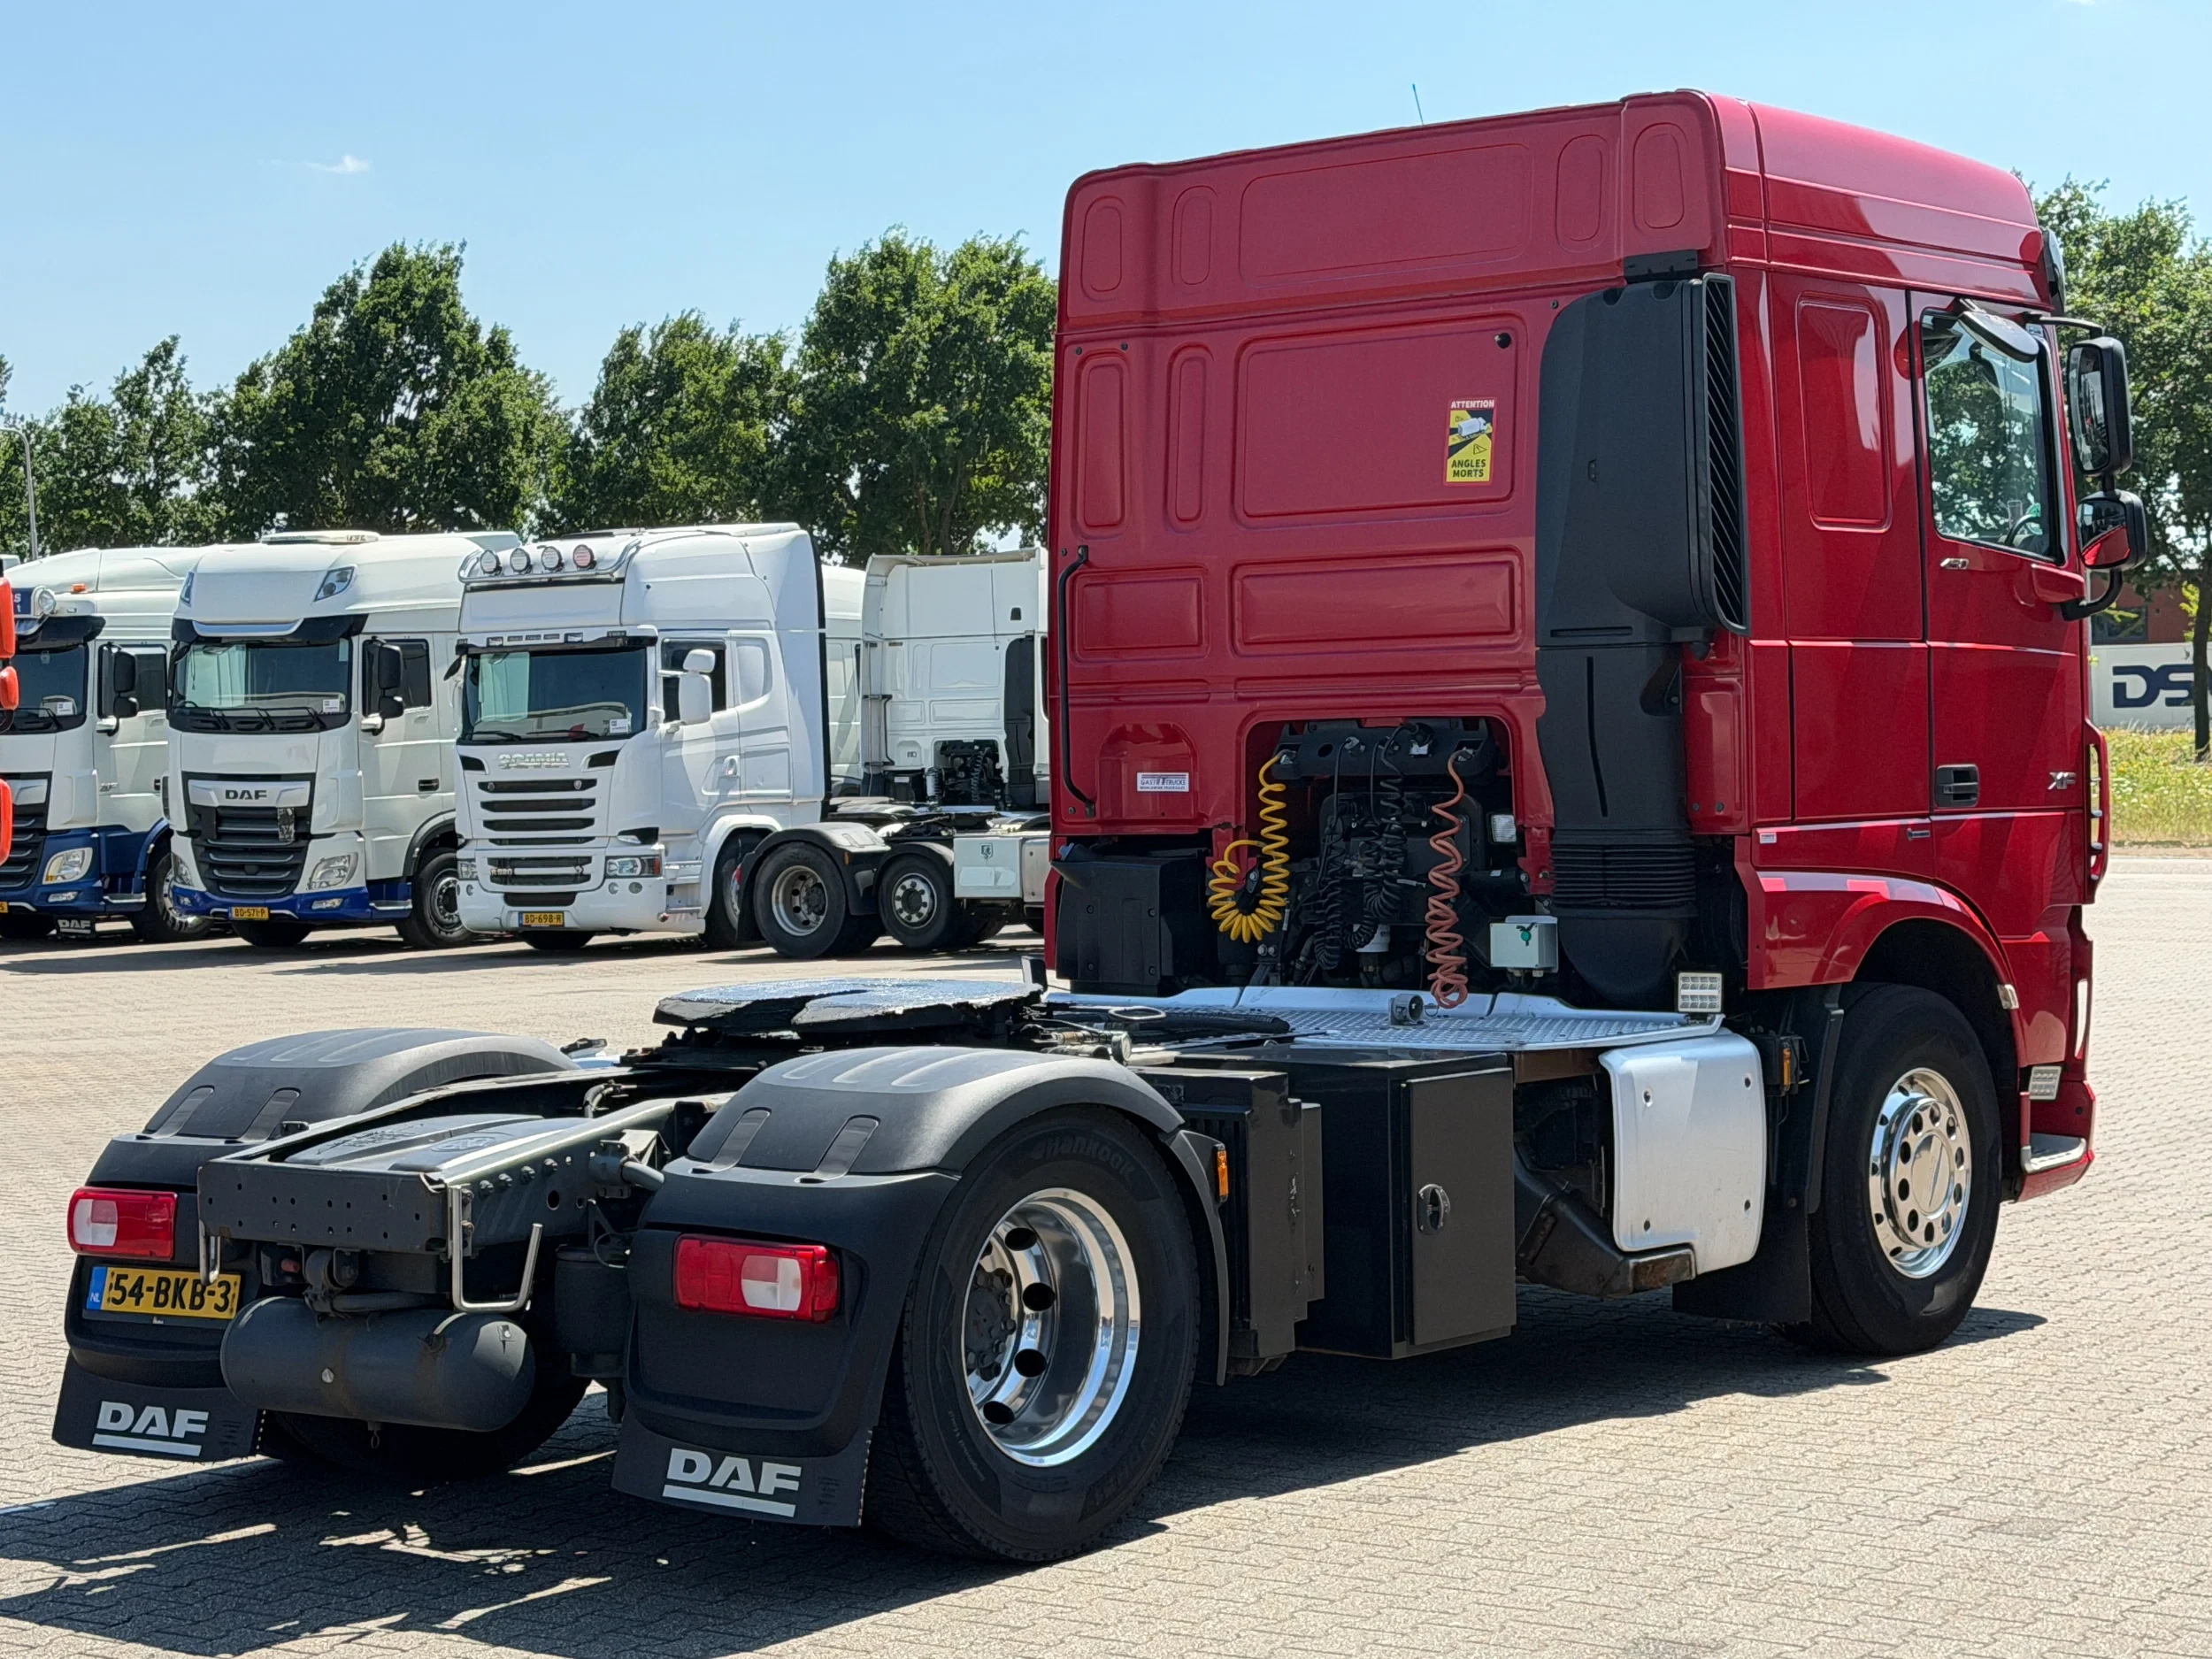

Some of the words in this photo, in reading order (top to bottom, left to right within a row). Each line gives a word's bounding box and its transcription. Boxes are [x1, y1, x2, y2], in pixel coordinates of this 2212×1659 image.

[1452, 459, 1486, 468] ANGLES
[1453, 469, 1484, 478] MORTS
[2112, 664, 2212, 708] DS
[2047, 772, 2076, 790] XF
[225, 789, 267, 800] DAF
[525, 914, 562, 924] BD-698-R
[90, 1292, 101, 1302] NL
[111, 1274, 232, 1313] 54-BKB-3
[96, 1401, 209, 1439] DAF
[666, 1448, 802, 1495] DAF
